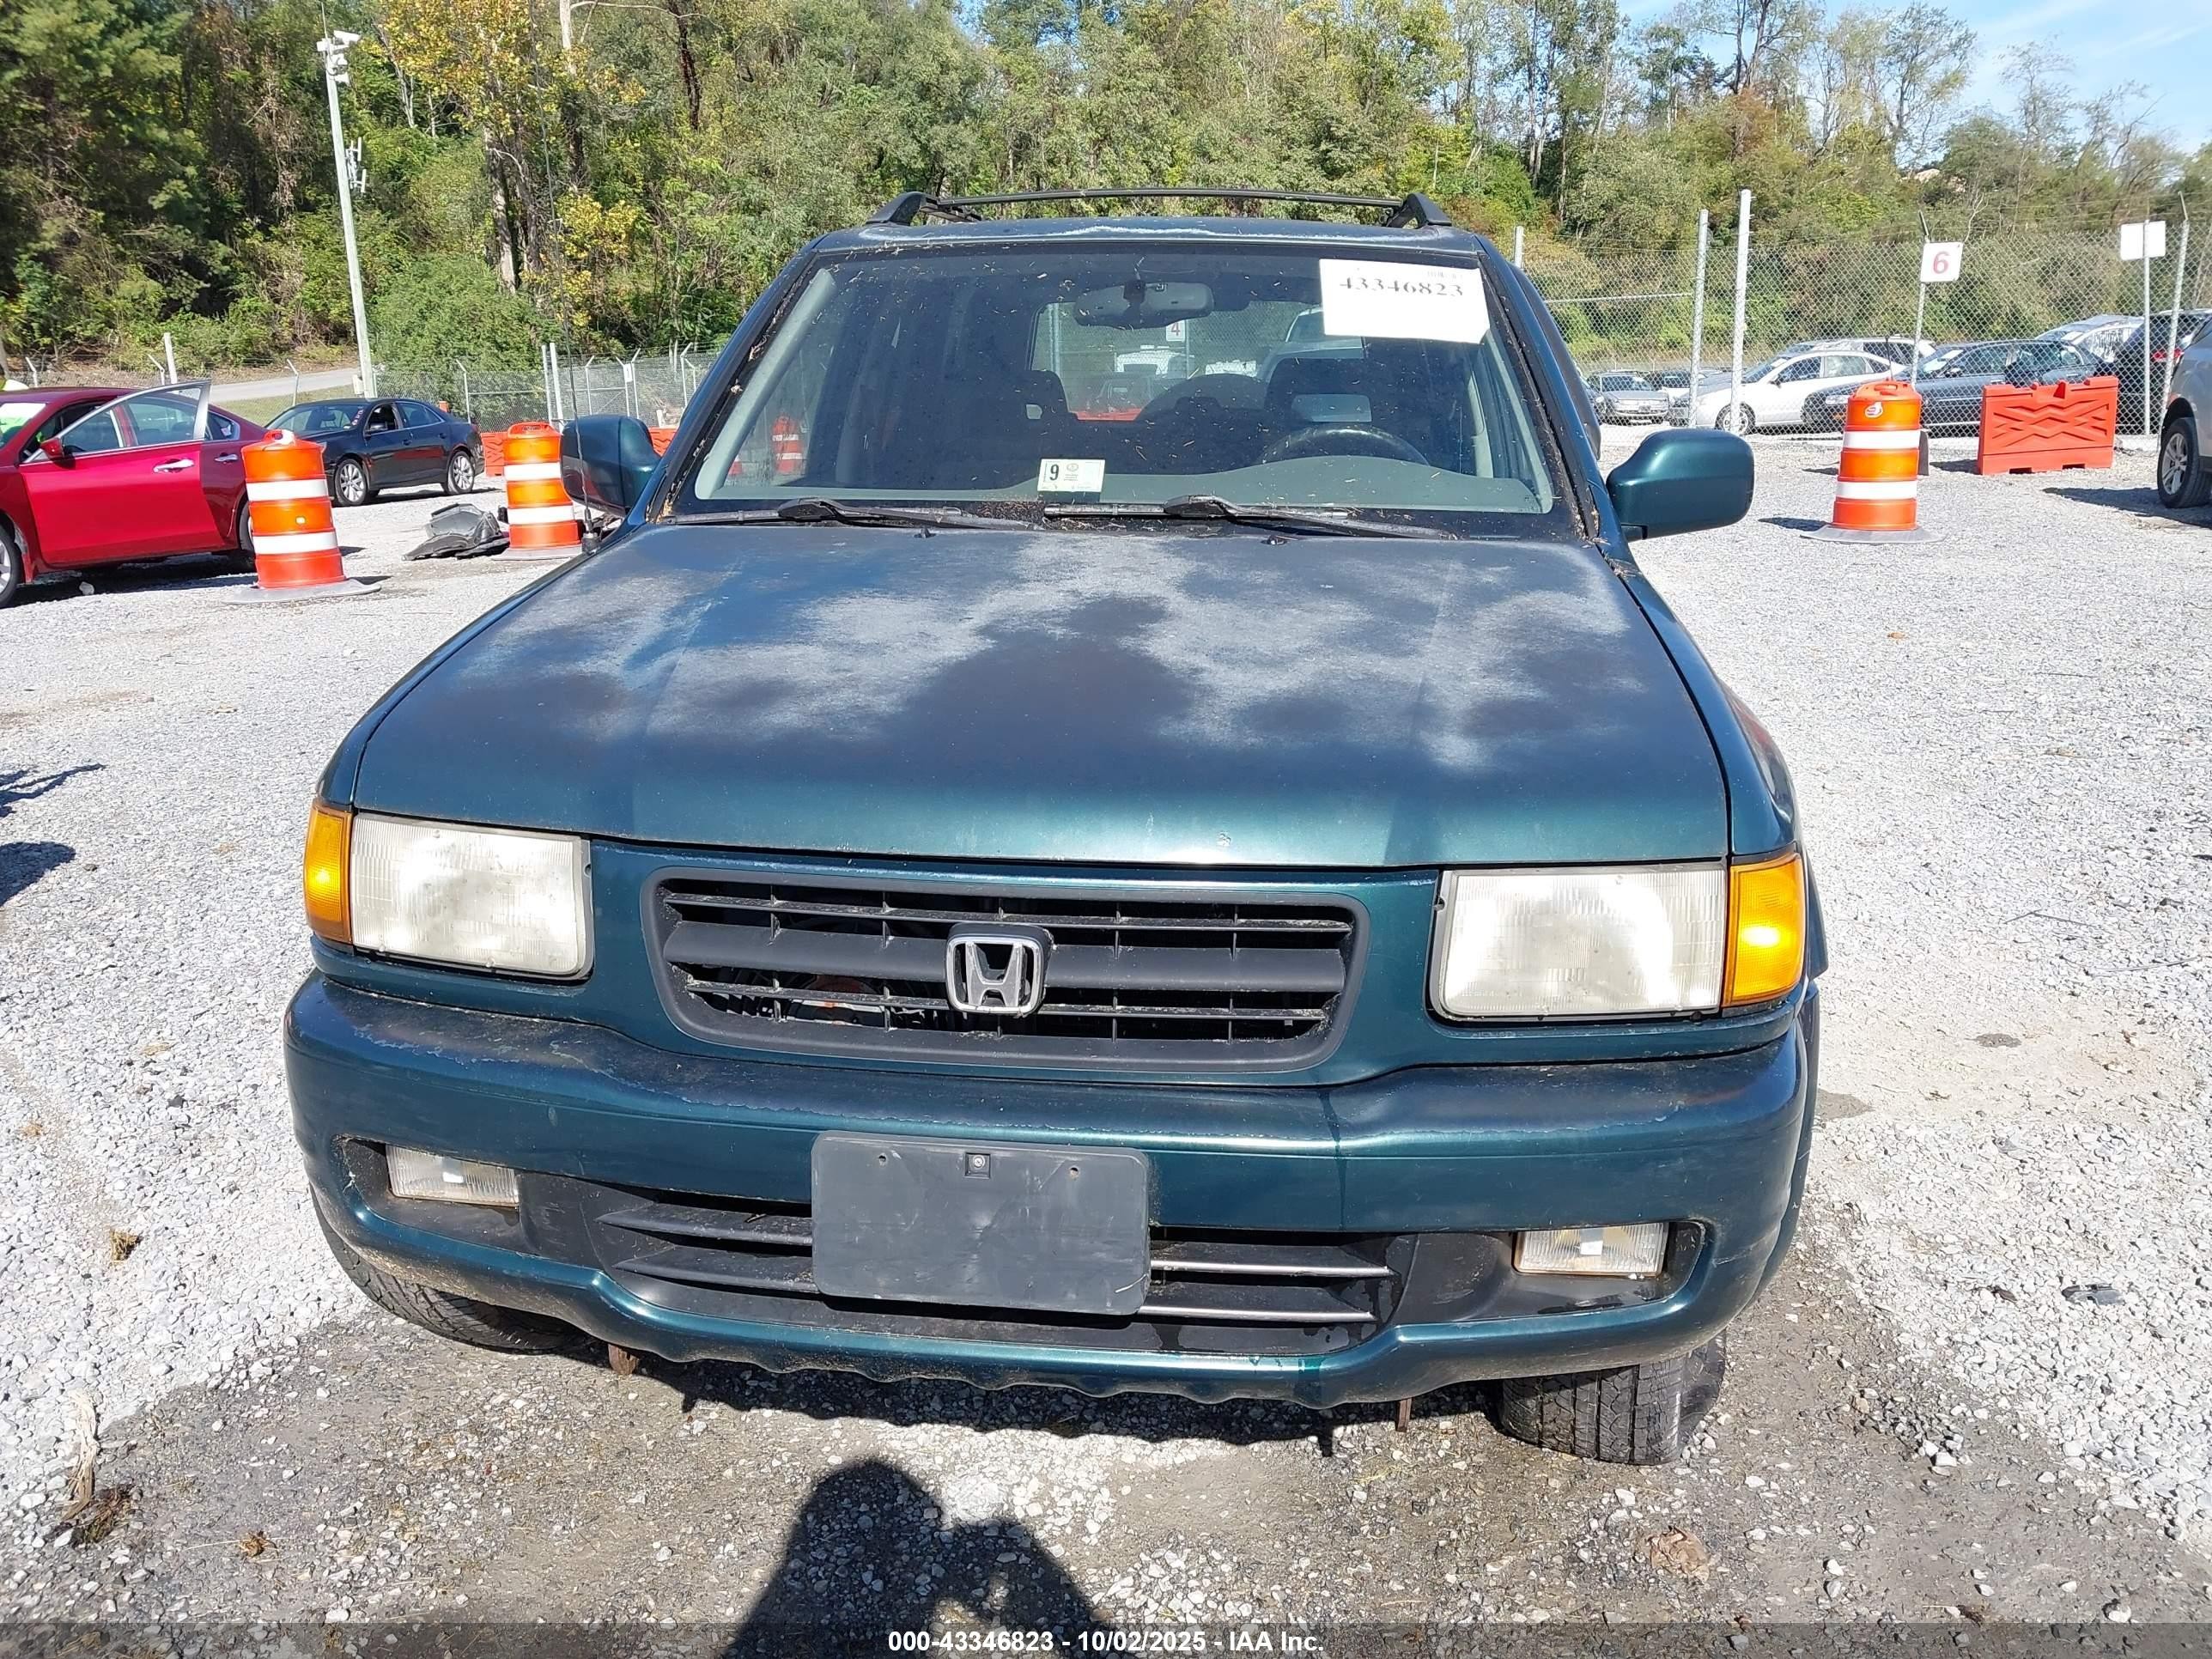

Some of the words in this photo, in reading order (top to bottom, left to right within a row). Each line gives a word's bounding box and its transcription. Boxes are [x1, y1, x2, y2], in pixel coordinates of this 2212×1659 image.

[1933, 251, 1950, 275] 6
[1340, 276, 1463, 297] 43346823
[1170, 321, 1182, 337] 4
[1049, 464, 1060, 481] 9
